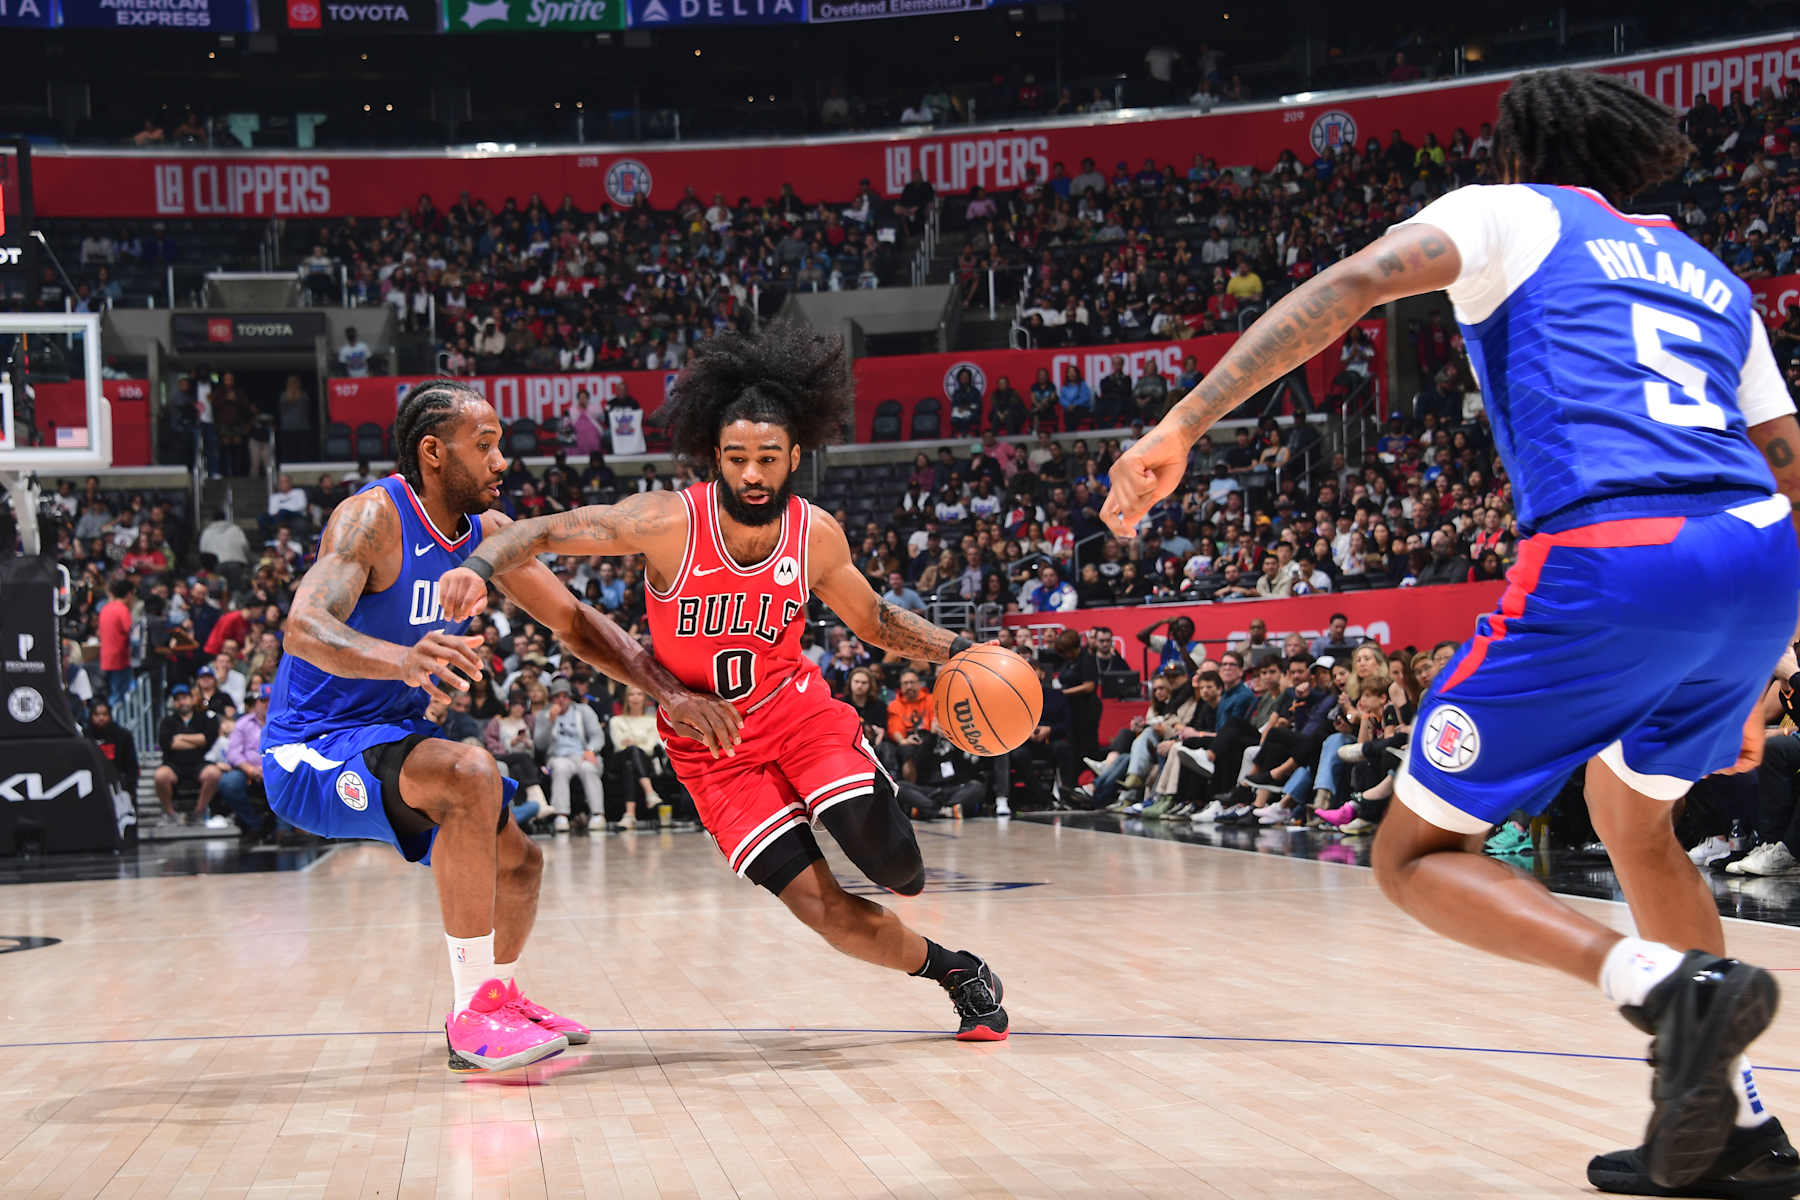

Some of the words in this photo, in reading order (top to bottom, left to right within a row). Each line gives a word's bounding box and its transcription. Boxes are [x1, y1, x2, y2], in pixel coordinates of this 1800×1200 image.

[116, 10, 210, 26] EXPRESS
[328, 5, 409, 21] TOYOTA
[526, 0, 606, 27] Sprite
[820, 1, 886, 18] Overland
[919, 136, 1049, 191] CLIPPERS
[154, 165, 185, 214] LA
[192, 165, 331, 214] CLIPPERS
[1584, 238, 1734, 315] HYLAND
[236, 323, 294, 337] TOYOTA
[1052, 346, 1182, 397] CIPES
[1631, 302, 1727, 431] 5
[713, 648, 757, 703] 0
